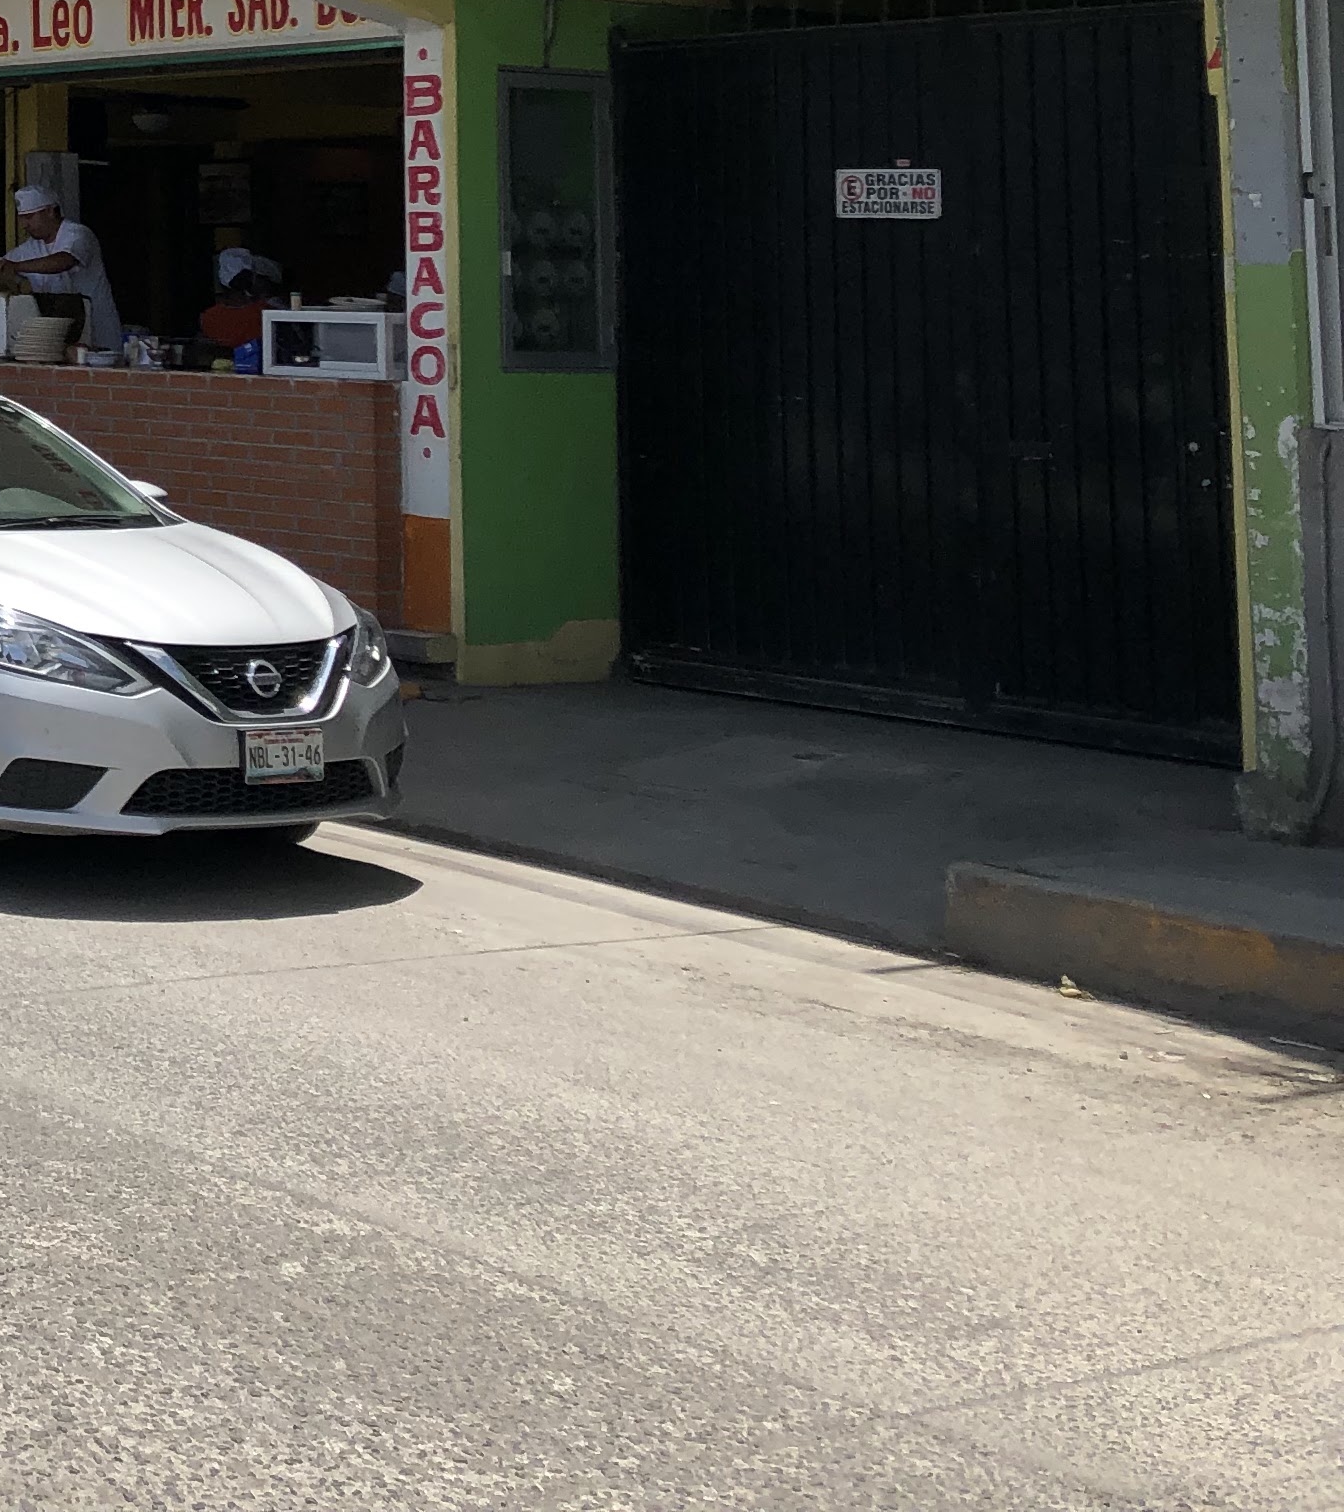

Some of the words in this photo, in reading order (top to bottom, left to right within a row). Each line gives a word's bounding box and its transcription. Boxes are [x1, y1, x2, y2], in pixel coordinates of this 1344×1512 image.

[864, 173, 936, 186] GRACIAS
[866, 187, 900, 200] POR
[911, 186, 936, 200] NO
[841, 200, 936, 214] ESTACIONARSE
[404, 73, 447, 440] BARBACOA
